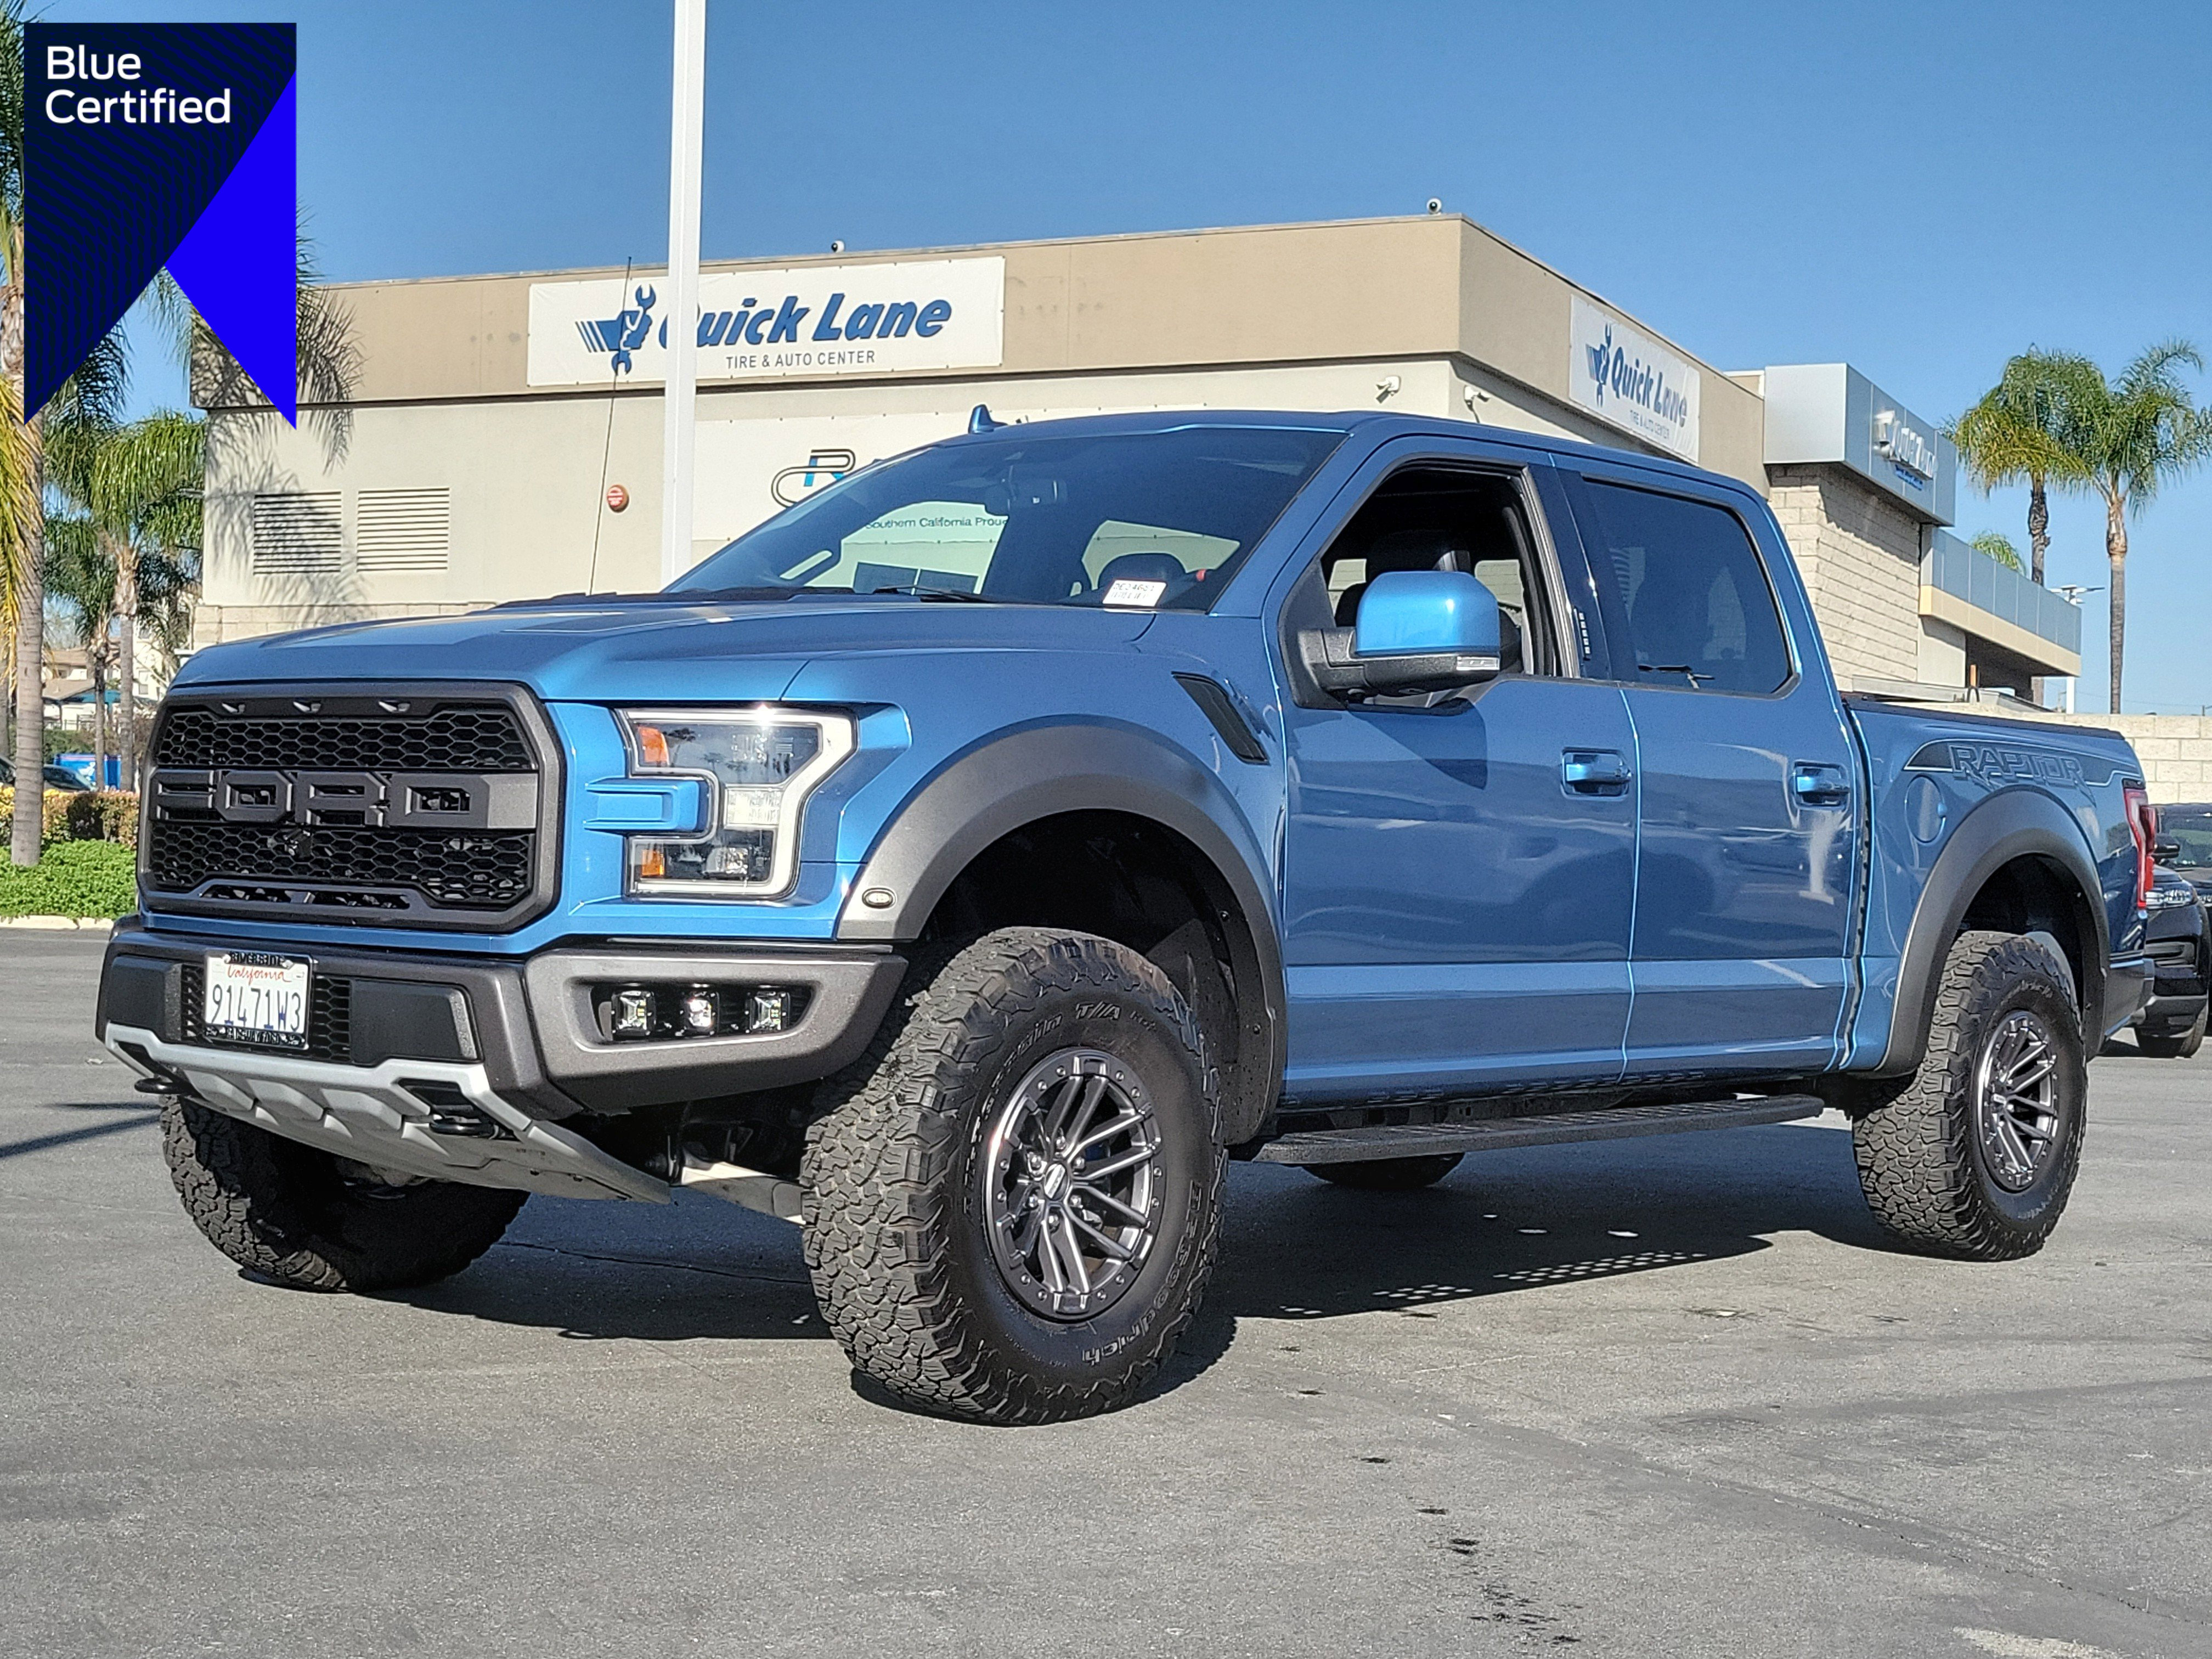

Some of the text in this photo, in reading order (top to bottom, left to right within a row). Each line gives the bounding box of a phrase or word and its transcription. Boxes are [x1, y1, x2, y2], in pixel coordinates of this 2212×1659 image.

[812, 293, 952, 341] Lane
[726, 349, 875, 369] TIRE & AUTO CENTER
[1612, 347, 1654, 408] Quick
[1654, 371, 1688, 428] Lane
[919, 517, 972, 528] California
[1948, 744, 2086, 789] RAPTOR
[145, 768, 491, 830] FORD
[227, 964, 292, 986] California
[212, 984, 301, 1031] 91471W3
